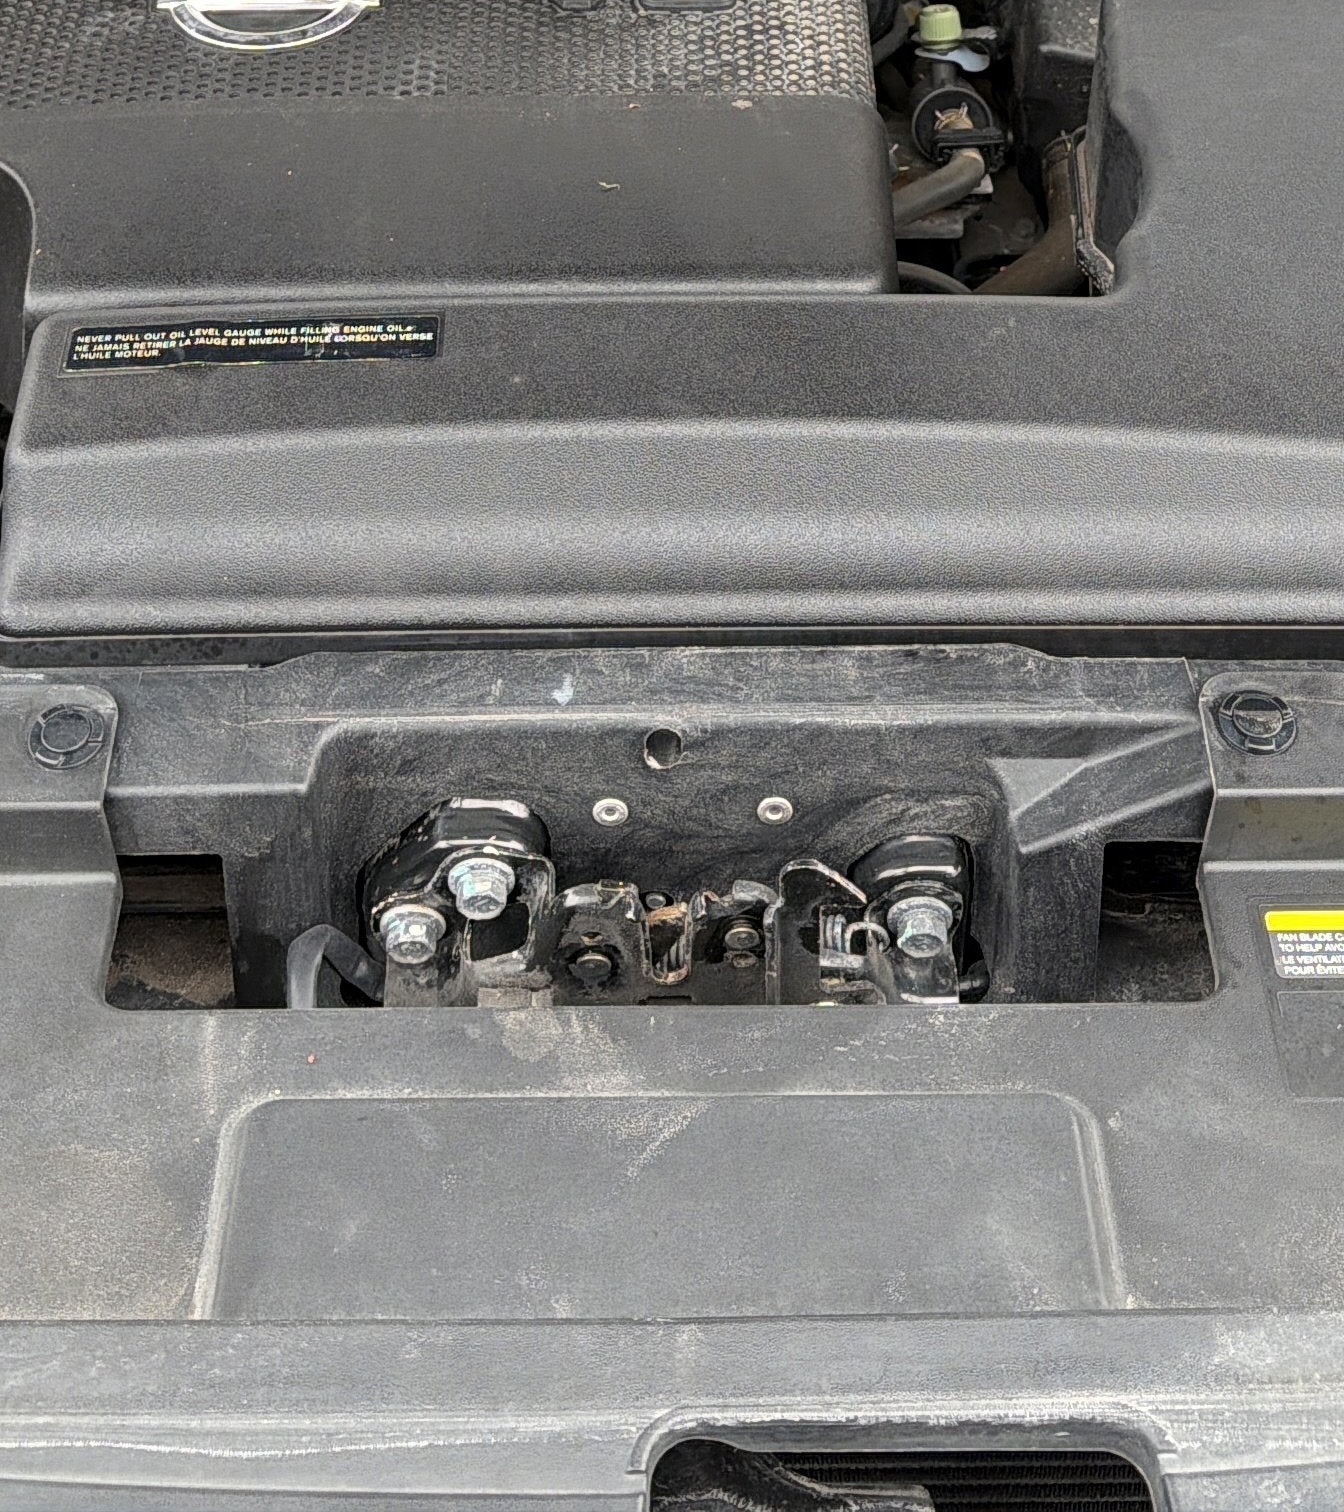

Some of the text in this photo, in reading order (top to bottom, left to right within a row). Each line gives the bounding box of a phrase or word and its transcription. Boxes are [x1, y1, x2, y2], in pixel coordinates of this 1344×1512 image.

[76, 334, 112, 343] NEVER
[114, 333, 140, 342] PULL
[144, 332, 166, 341] OUT
[169, 331, 186, 339] OIL
[189, 328, 220, 337] LEVEL
[223, 328, 261, 337] GAUGE
[264, 327, 297, 335] WHILE
[299, 325, 340, 334] FILLING
[343, 324, 384, 333] ENGINE
[75, 344, 88, 352] NE
[91, 342, 129, 351] JAMAIS
[132, 341, 176, 350] RETIRER
[178, 339, 191, 347] LA
[194, 337, 228, 346] JAUGE
[230, 337, 246, 346] DE
[248, 336, 288, 345] NIVEAU
[399, 332, 434, 341] VERSE
[73, 350, 161, 360] L'HUILE MOTEUR.
[1277, 933, 1298, 942] FAN
[1299, 933, 1332, 942] BLADE
[1279, 943, 1295, 952] TO
[1296, 943, 1323, 952] HELP
[1282, 955, 1295, 964] LE
[1284, 965, 1315, 975] POUR
